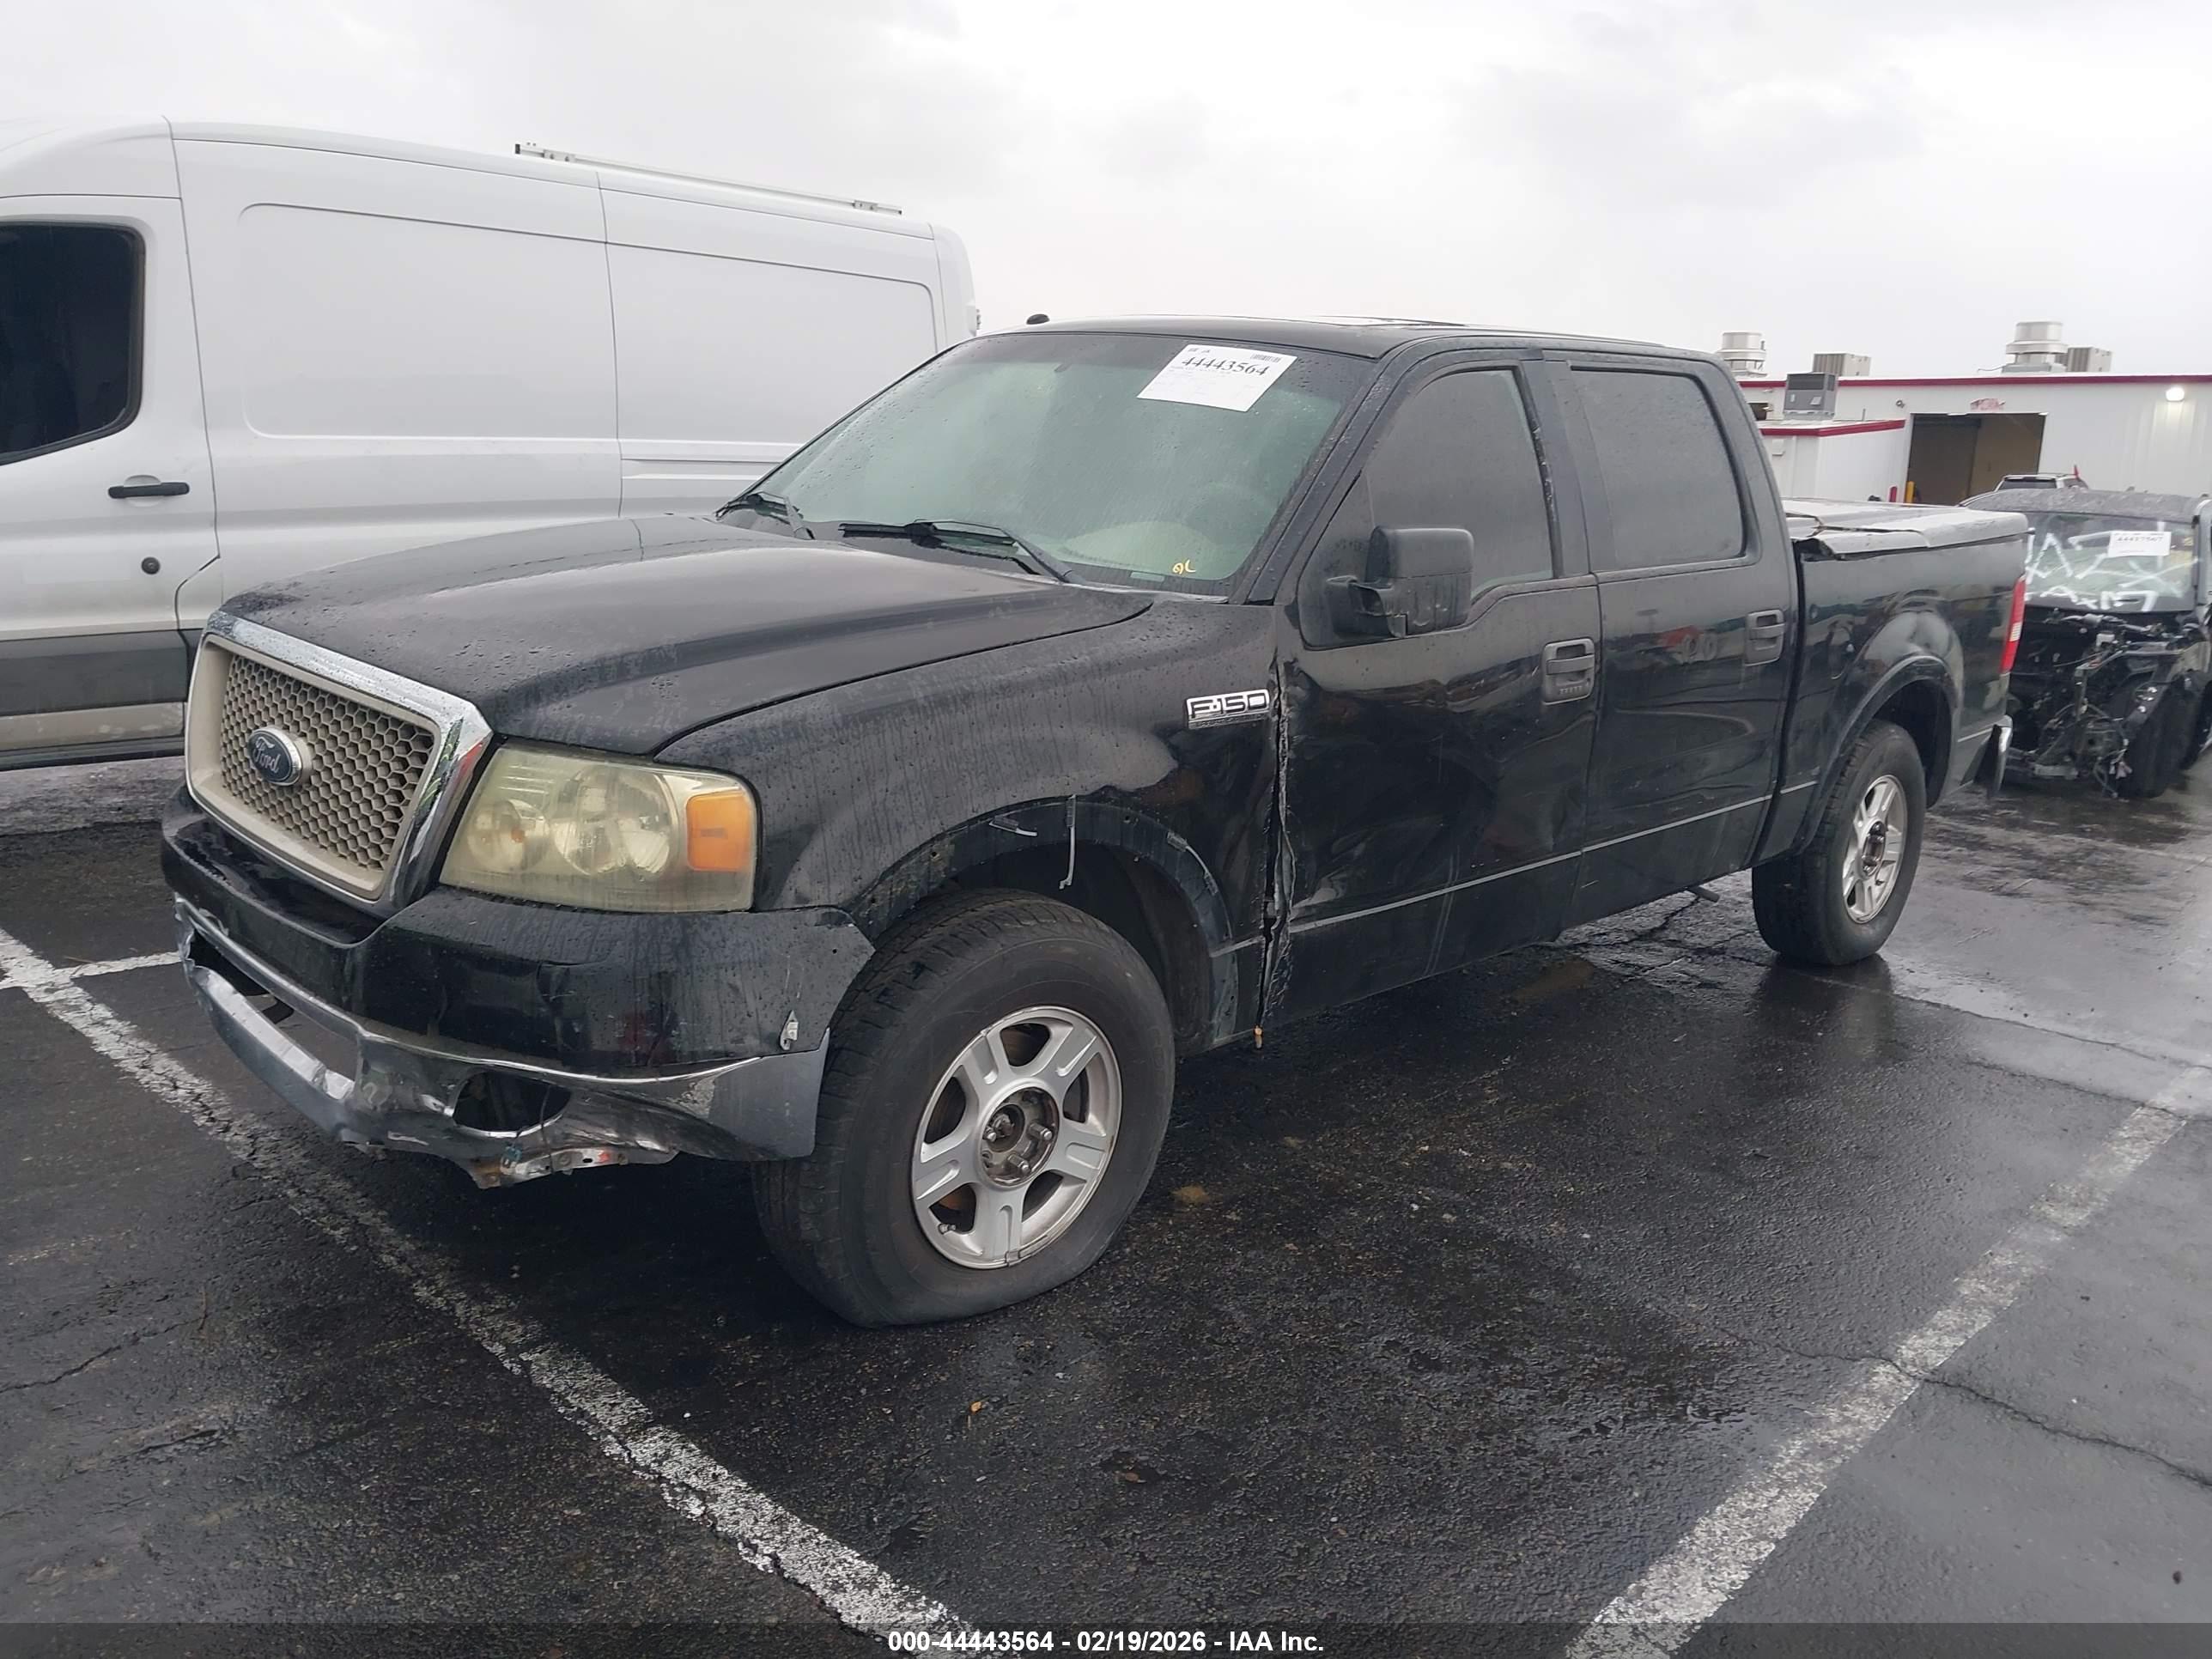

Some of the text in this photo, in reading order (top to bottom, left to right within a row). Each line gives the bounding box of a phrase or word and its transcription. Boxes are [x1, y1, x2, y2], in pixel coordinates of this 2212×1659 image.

[1182, 356, 1270, 376] 44443564
[1188, 690, 1269, 720] F-150
[252, 736, 280, 774] Ford
